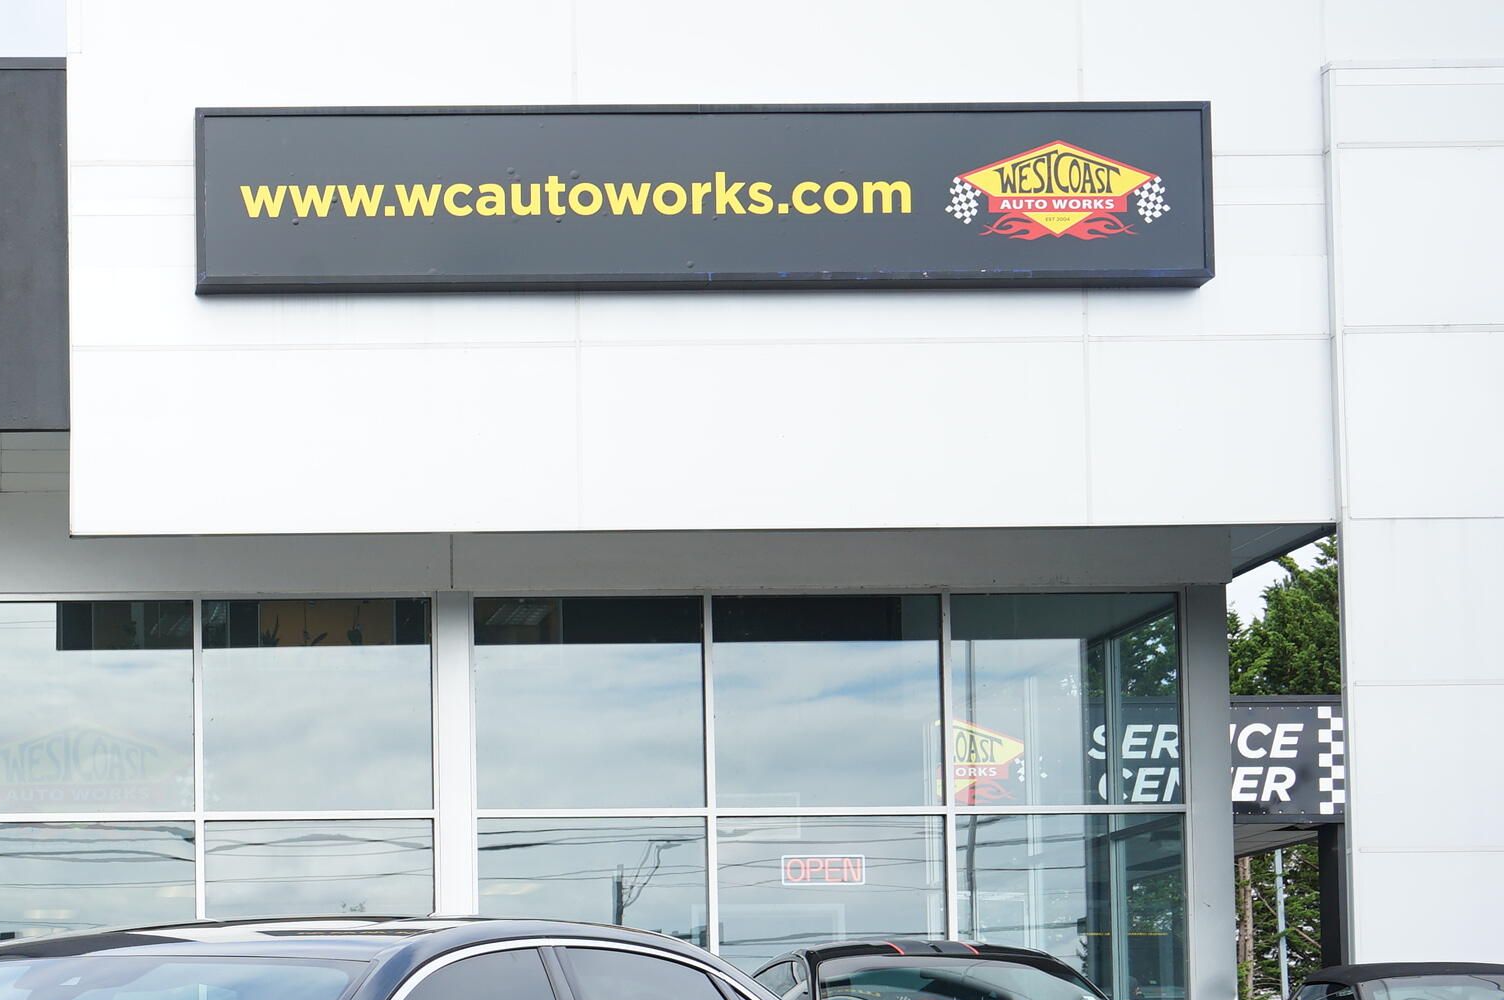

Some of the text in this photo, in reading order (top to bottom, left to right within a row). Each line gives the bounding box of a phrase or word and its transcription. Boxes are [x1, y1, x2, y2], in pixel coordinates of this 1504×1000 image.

[240, 171, 913, 218] www.wcautoworks.com
[1000, 199, 1115, 210] AUTO WORKS
[955, 767, 998, 777] ORKS
[7, 788, 64, 800] AUTO
[786, 858, 862, 882] OPEN
